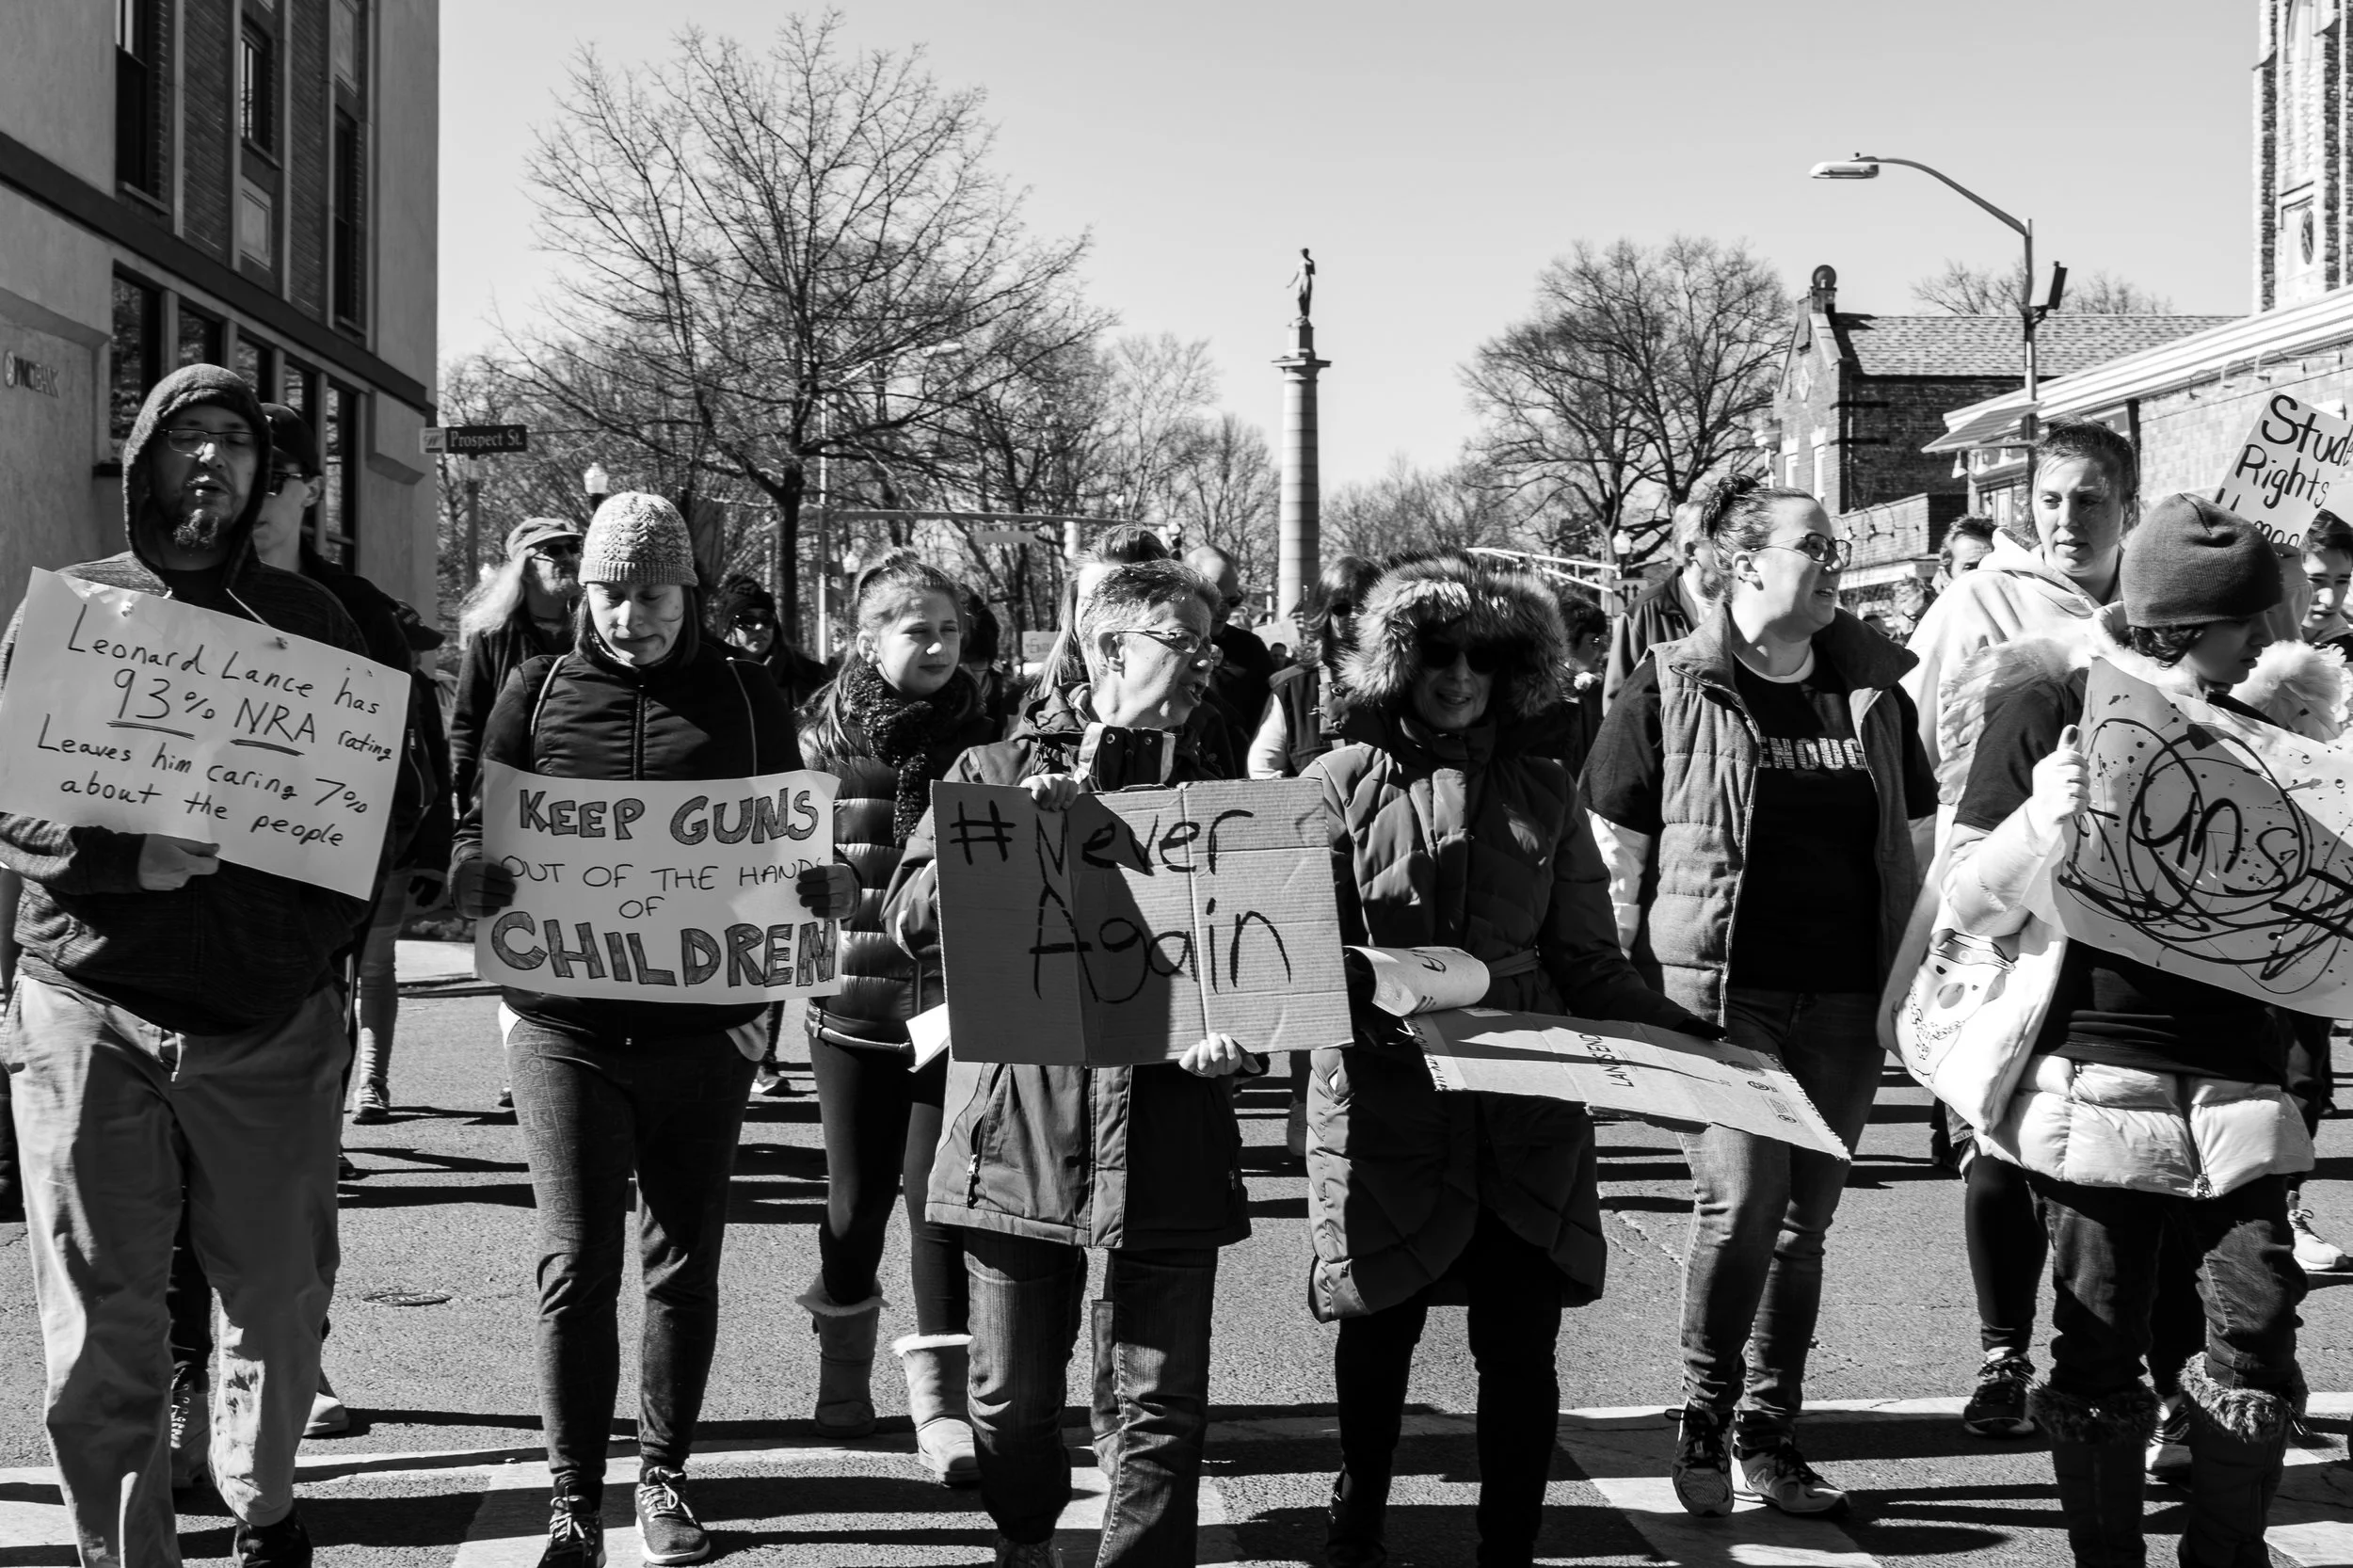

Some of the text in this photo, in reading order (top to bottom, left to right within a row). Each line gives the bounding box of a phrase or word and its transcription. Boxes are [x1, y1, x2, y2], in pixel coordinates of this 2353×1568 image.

[450, 430, 504, 448] Prospect
[507, 429, 523, 446] St.
[2234, 443, 2329, 509] Rights
[68, 603, 380, 714] Leonard Lance has
[234, 697, 316, 744] NRA
[337, 730, 392, 761] rating
[37, 713, 368, 814] Leaves him caring 7%
[60, 771, 345, 847] about the people
[520, 788, 819, 845] KEEP GUNS
[501, 855, 566, 883] OUT
[583, 864, 634, 888] OF
[650, 866, 719, 891] THE
[618, 896, 664, 919] OF
[490, 910, 837, 988] CHILDREN
[1029, 883, 1292, 1004] Again
